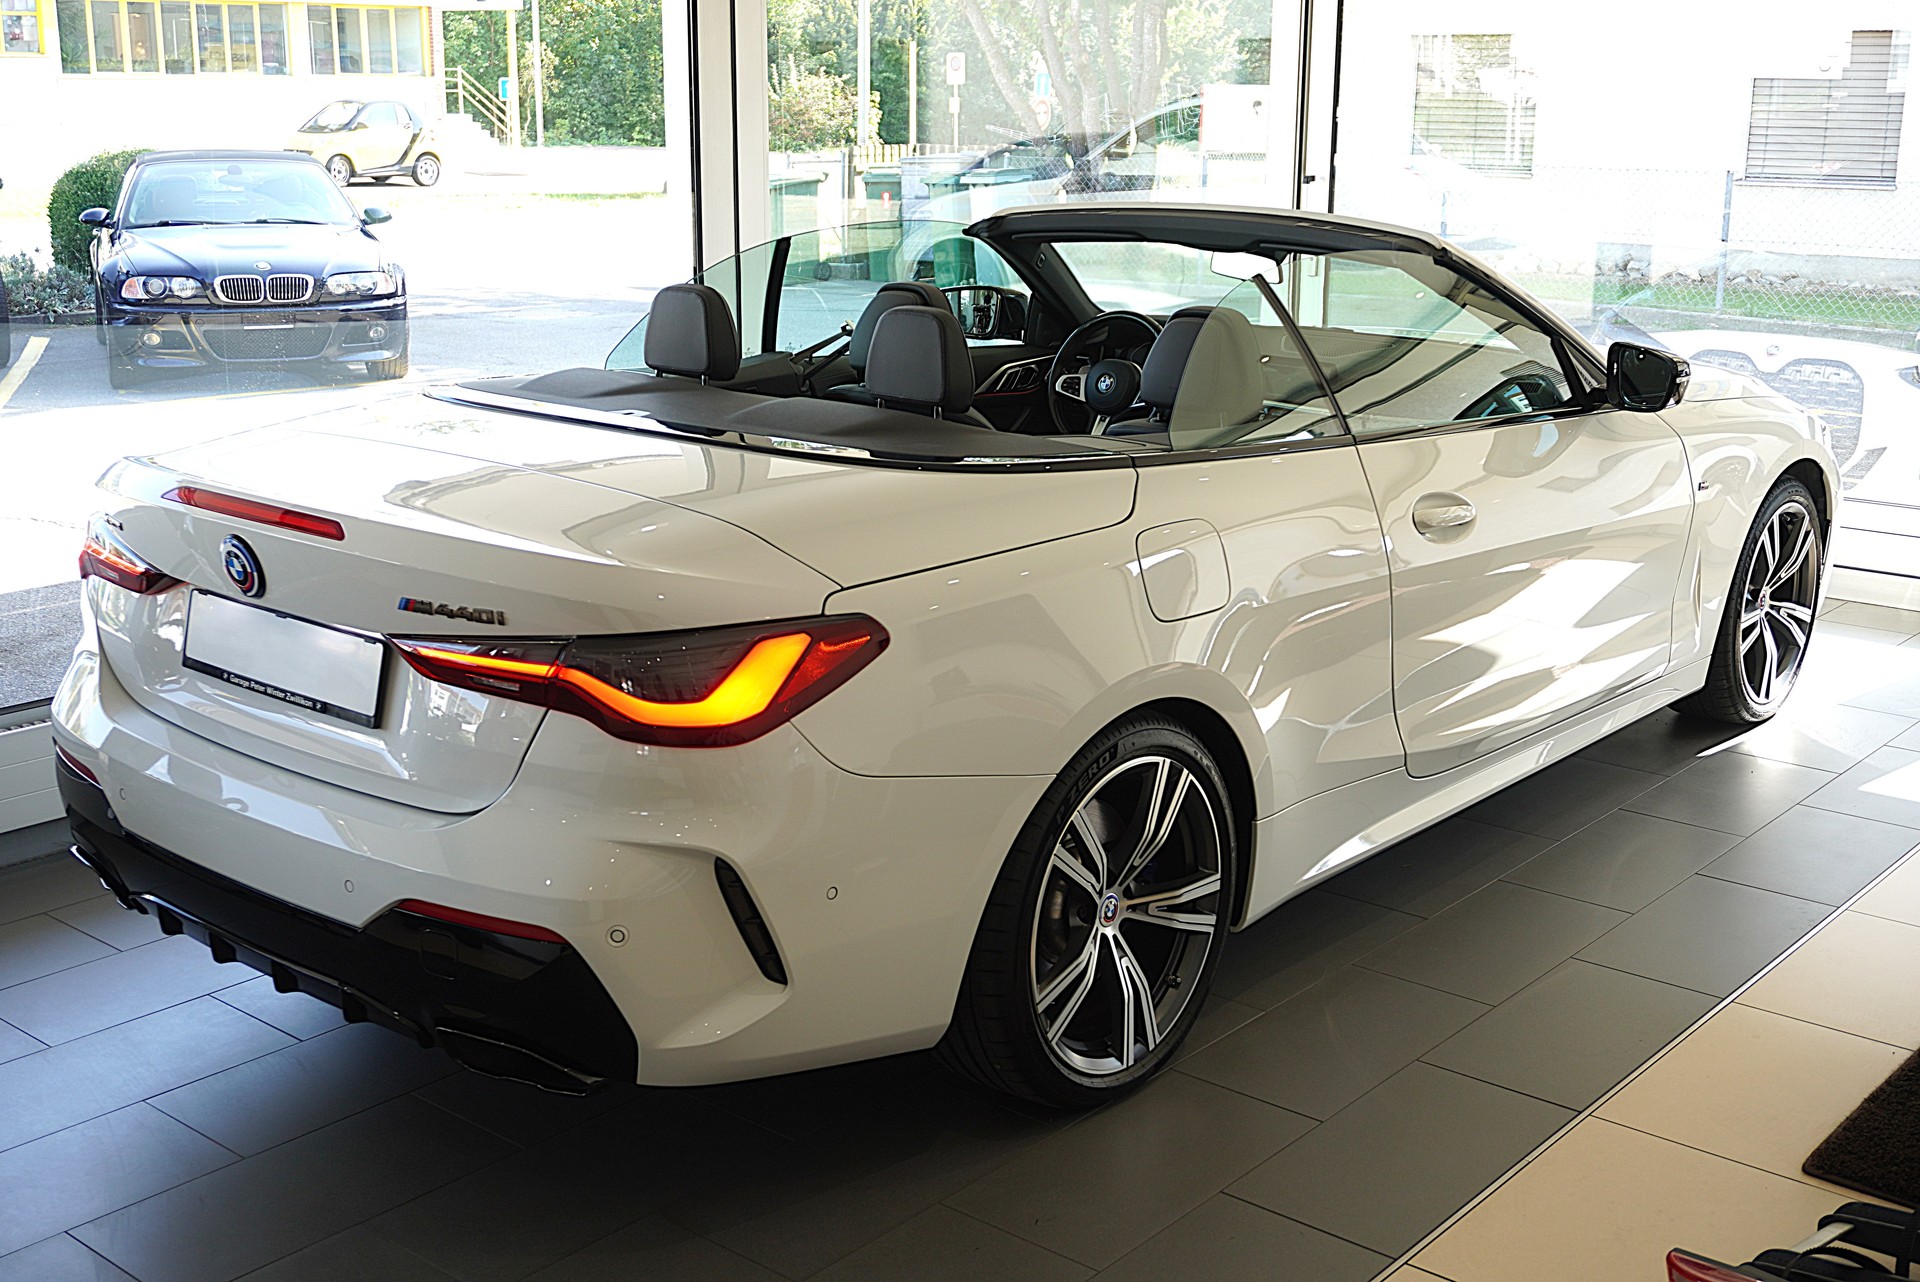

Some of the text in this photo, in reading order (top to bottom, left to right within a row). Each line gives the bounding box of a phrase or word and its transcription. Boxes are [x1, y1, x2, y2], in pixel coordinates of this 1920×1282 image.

[412, 599, 507, 626] M440i
[229, 674, 250, 688] Garage
[250, 681, 266, 692] Peter
[266, 686, 286, 699] Winter
[1067, 750, 1111, 806] ZERO
